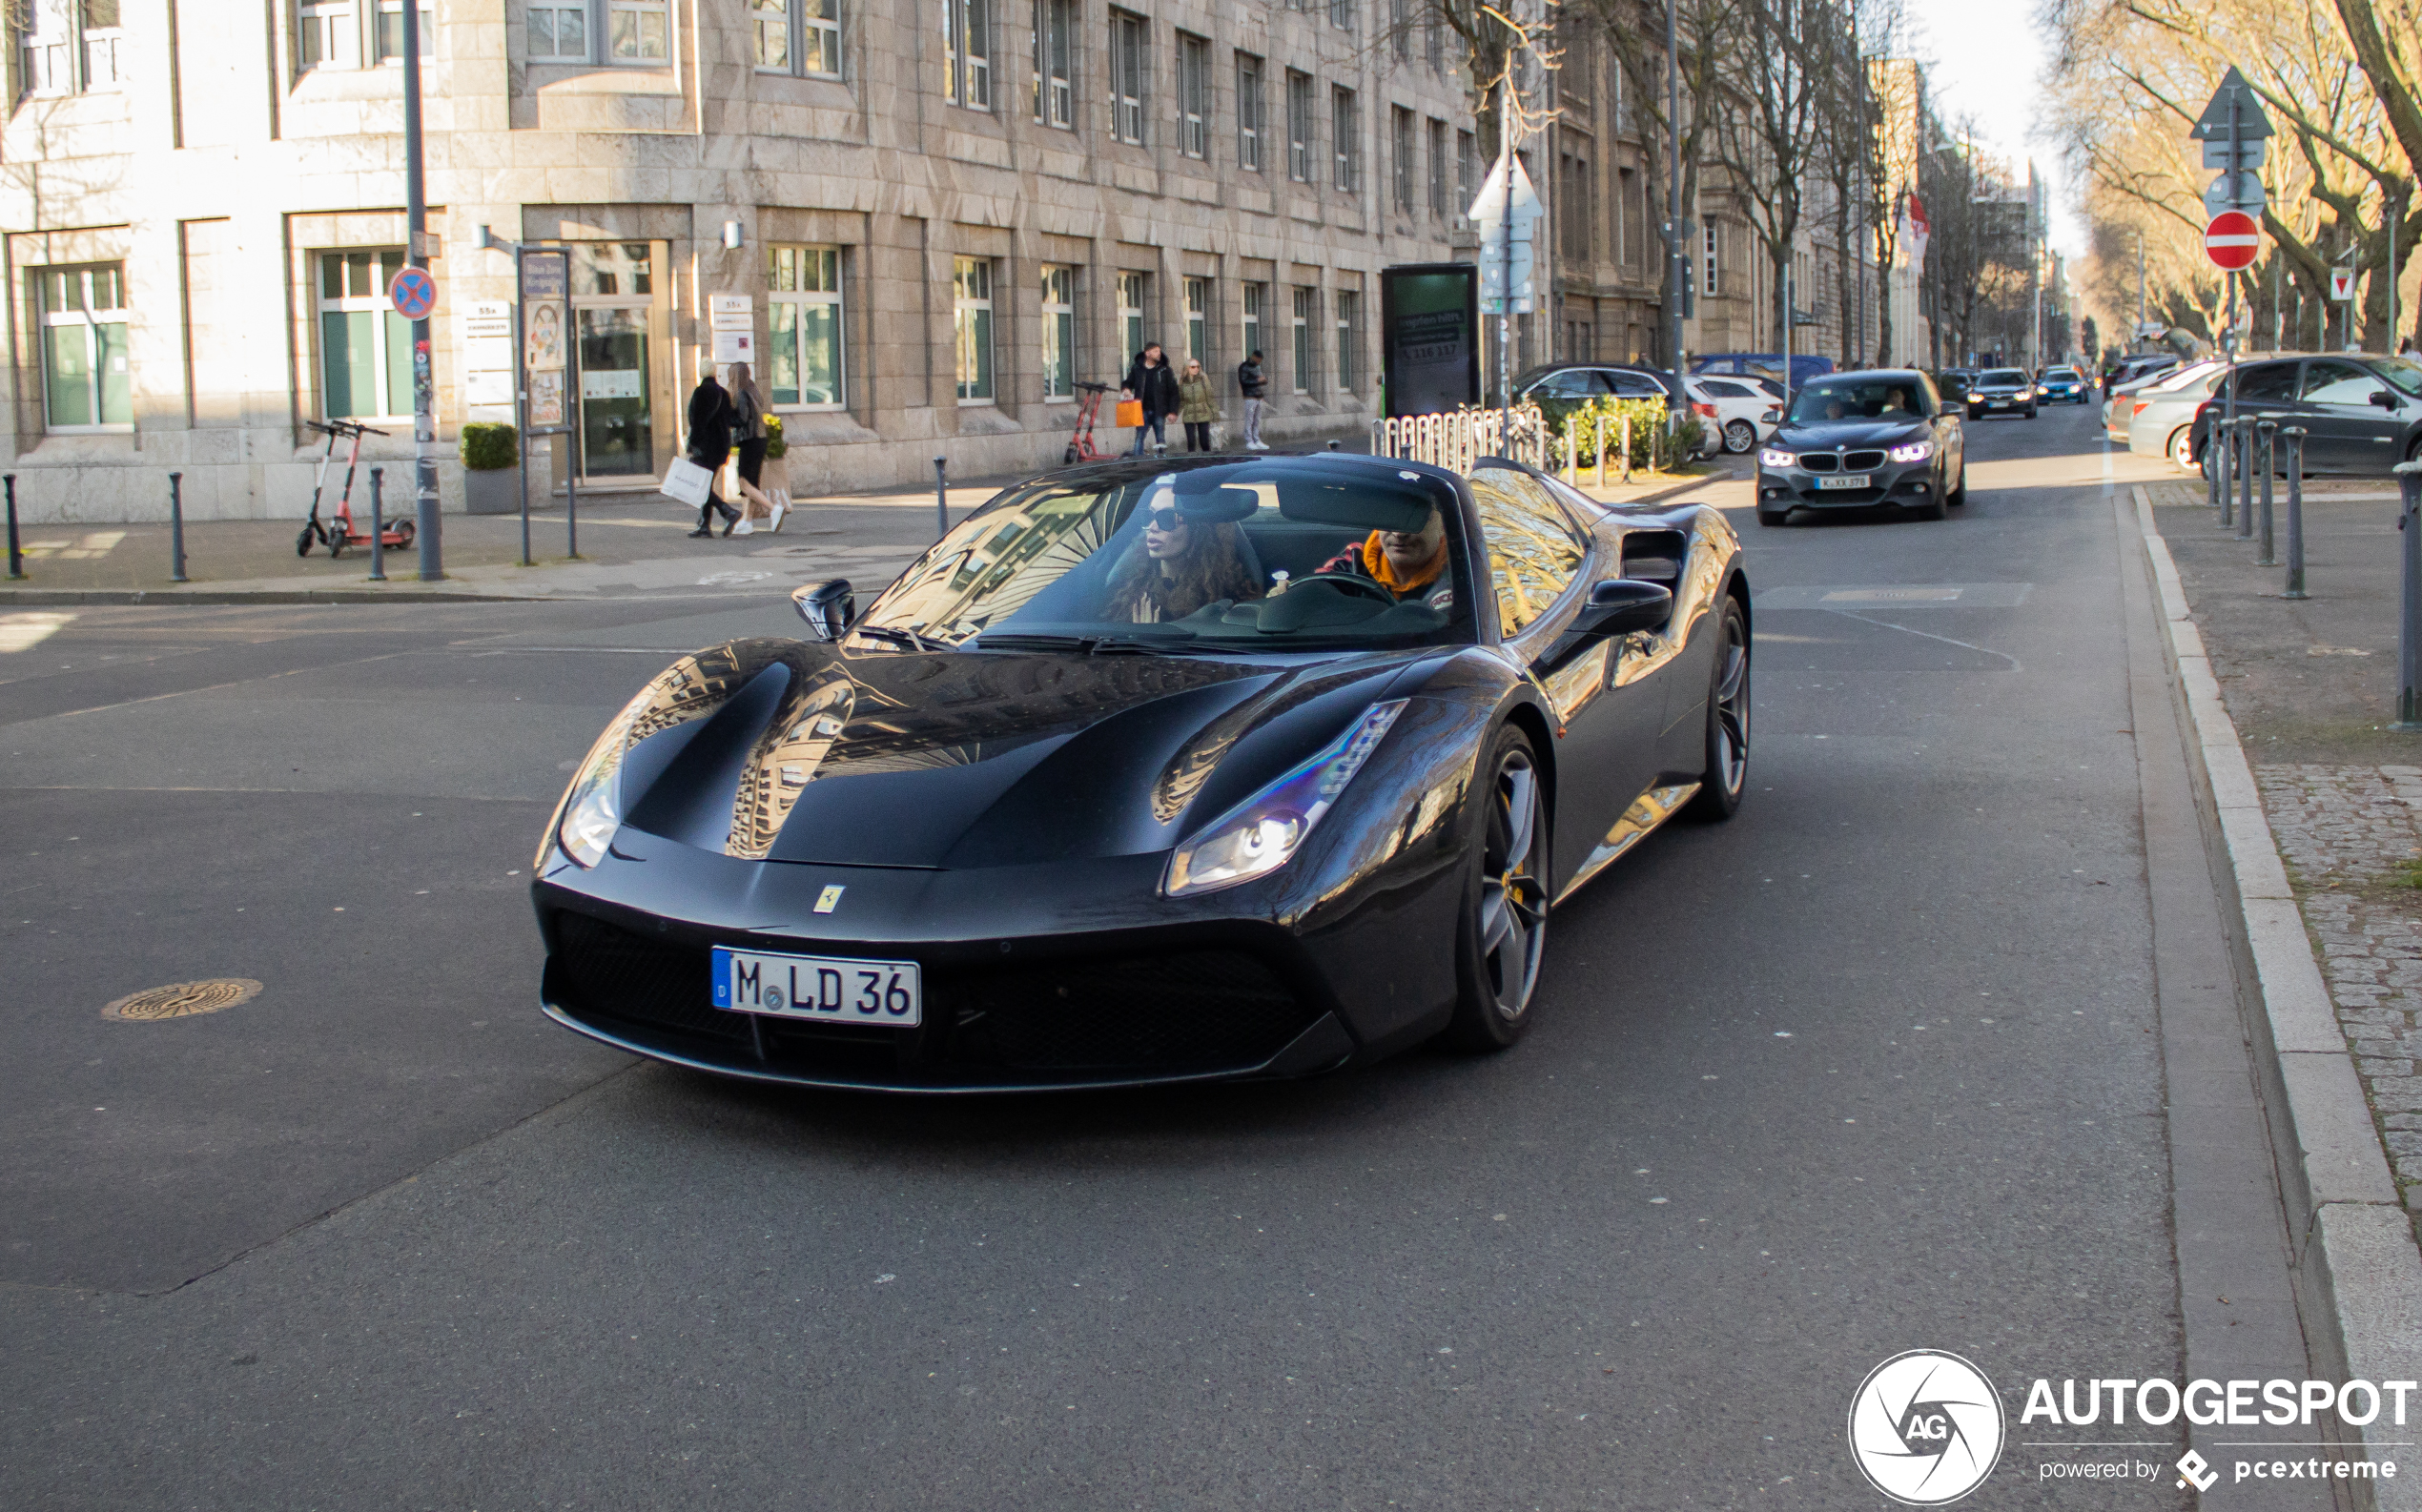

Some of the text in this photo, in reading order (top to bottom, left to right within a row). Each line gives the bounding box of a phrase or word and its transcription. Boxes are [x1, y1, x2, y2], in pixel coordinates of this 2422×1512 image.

[1413, 345, 1457, 358] 116 117
[1822, 479, 1829, 487] K
[737, 960, 761, 1005] M
[790, 966, 842, 1011] LD
[856, 970, 911, 1016] 36
